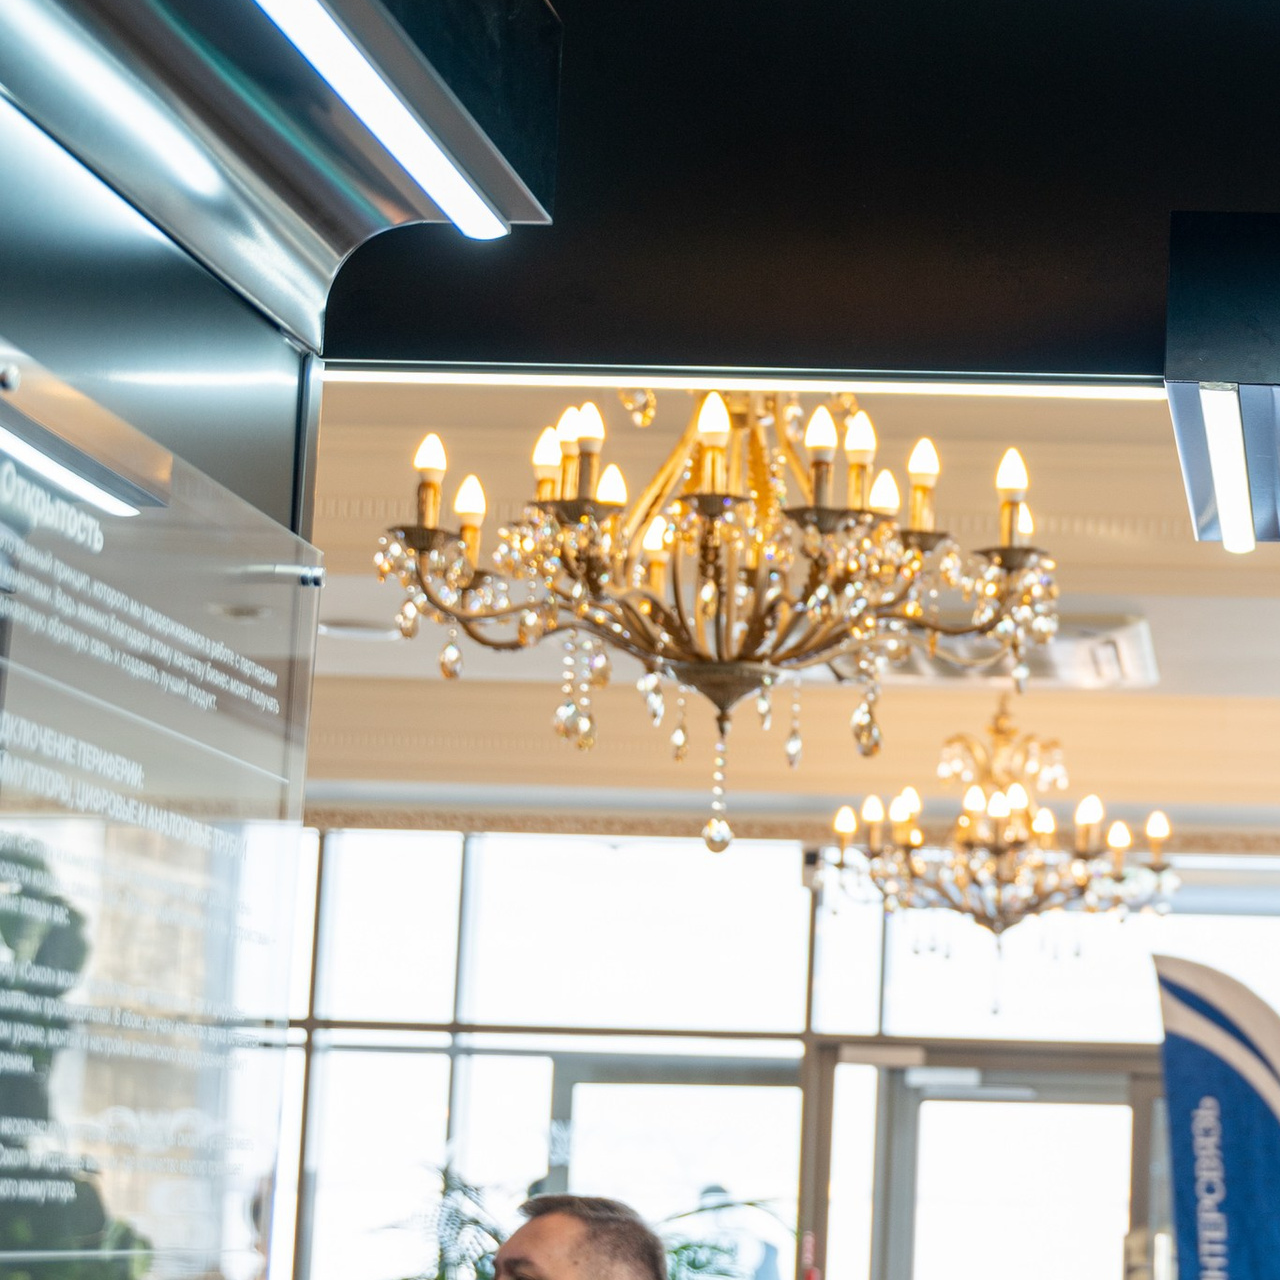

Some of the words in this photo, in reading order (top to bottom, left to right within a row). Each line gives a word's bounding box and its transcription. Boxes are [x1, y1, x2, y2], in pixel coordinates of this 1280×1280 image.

[1, 459, 104, 554] Открытость
[54, 560, 91, 597] принцип,
[93, 579, 128, 611] которого
[130, 598, 141, 618] мы
[56, 585, 76, 616] Ведь
[78, 601, 108, 631] именно
[48, 615, 88, 653] обратную
[90, 637, 112, 661] связь
[78, 739, 143, 788] ПЕРИФЕРИИ:
